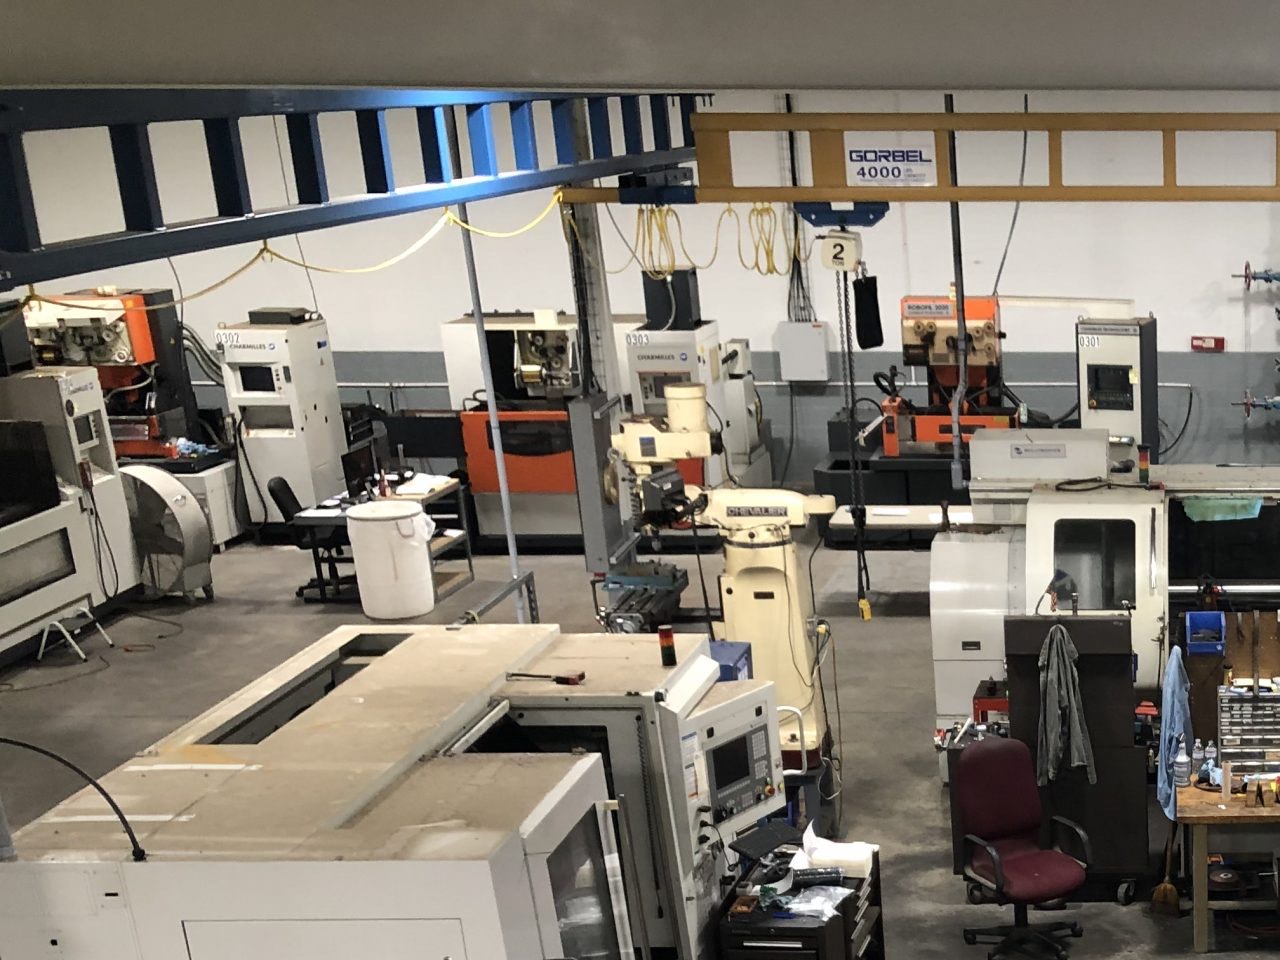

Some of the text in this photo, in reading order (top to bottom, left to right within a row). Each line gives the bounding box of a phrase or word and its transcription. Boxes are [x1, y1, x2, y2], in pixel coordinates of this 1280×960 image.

[849, 150, 932, 162] GORBEL
[857, 166, 901, 178] 4000
[832, 243, 845, 260] 2
[626, 334, 649, 345] 0303
[1080, 336, 1099, 347] 0301
[728, 507, 786, 516] CHEVALIER
